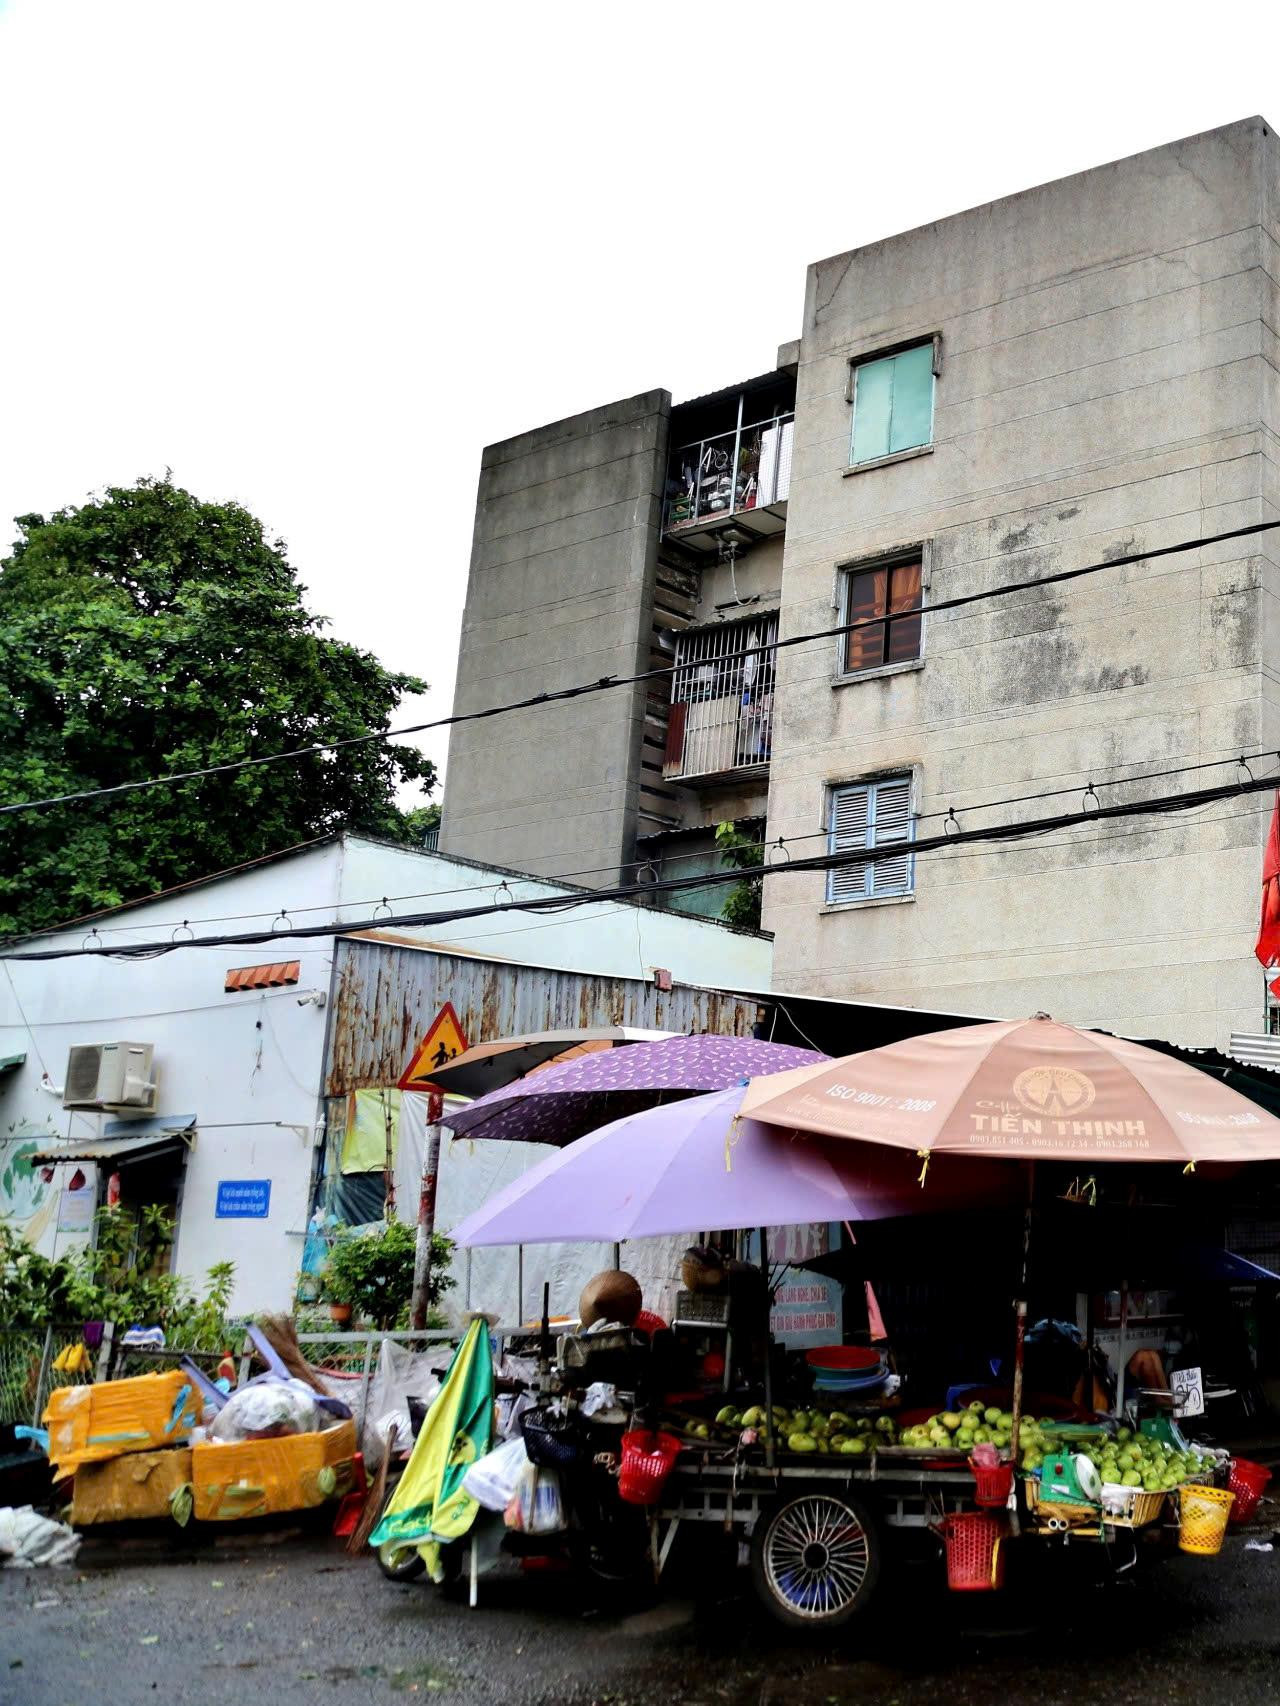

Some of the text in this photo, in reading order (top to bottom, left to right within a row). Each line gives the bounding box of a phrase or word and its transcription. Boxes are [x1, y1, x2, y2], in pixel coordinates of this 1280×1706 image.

[825, 1084, 856, 1099] ISO
[854, 1091, 890, 1107] 9001
[898, 1098, 937, 1112] 2008
[1052, 1120, 1146, 1139] THỊNH
